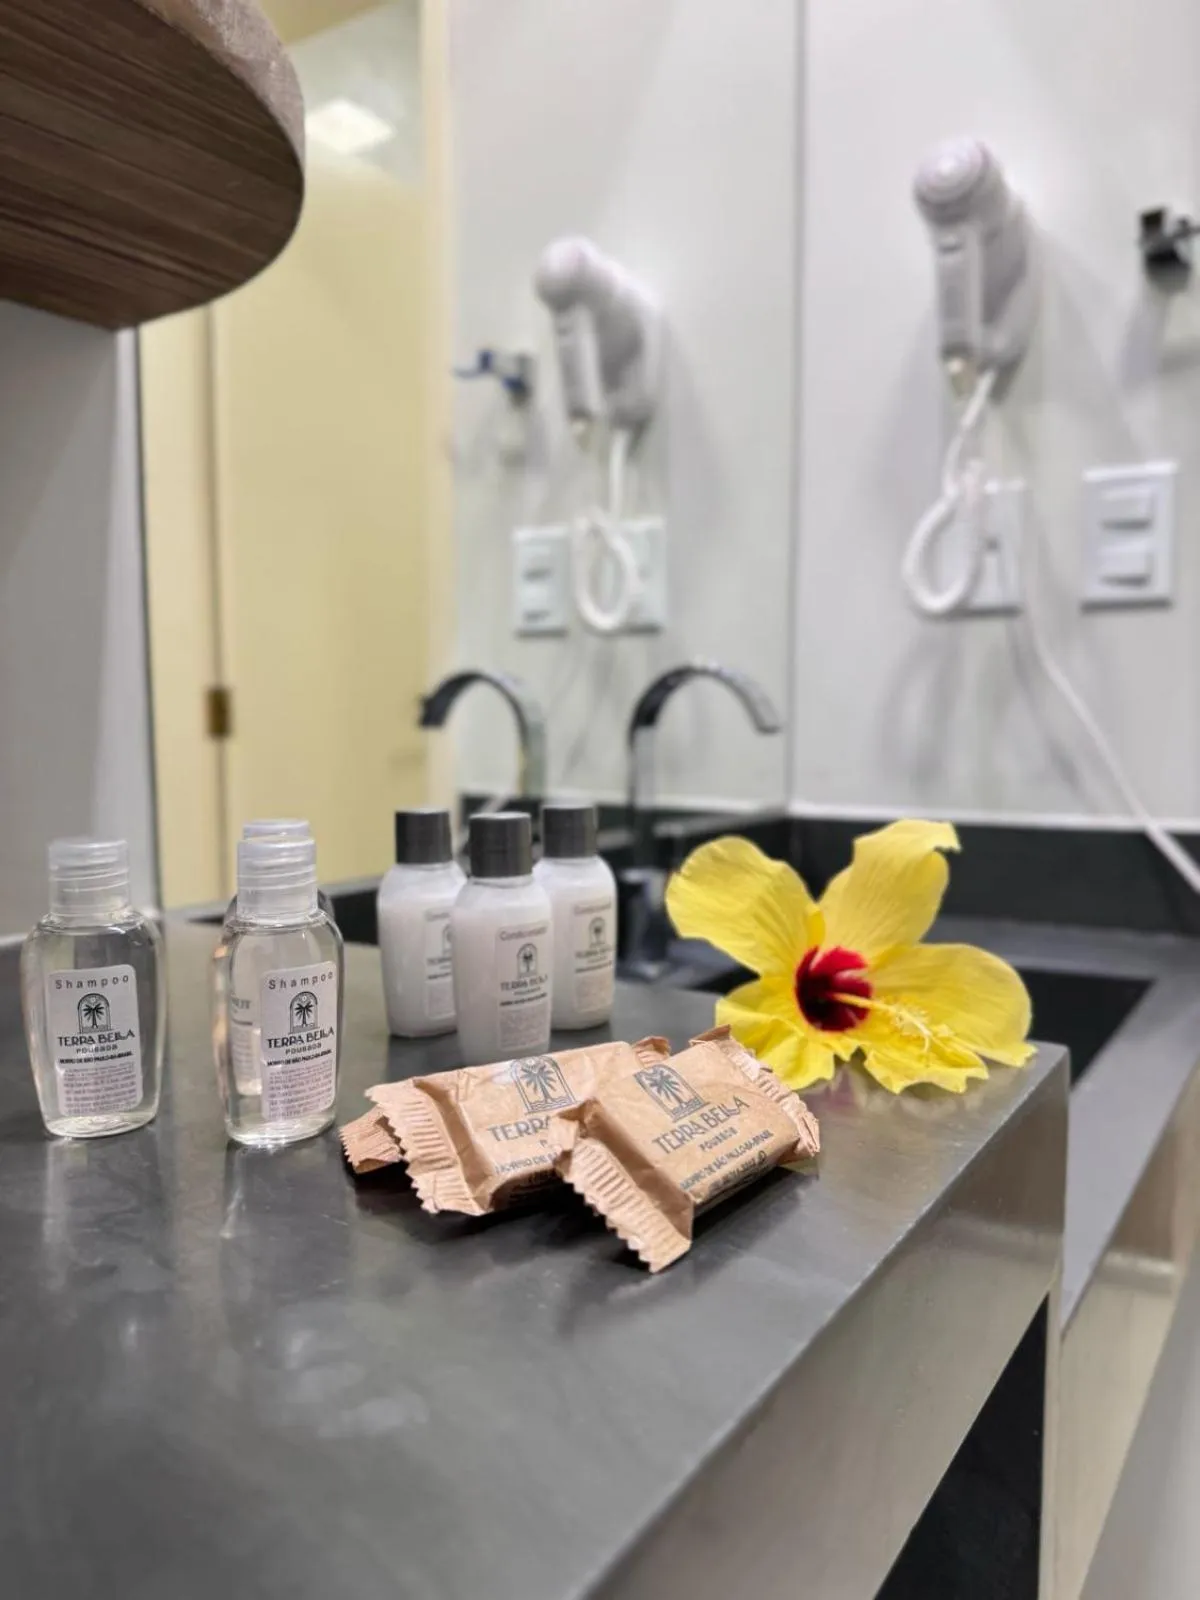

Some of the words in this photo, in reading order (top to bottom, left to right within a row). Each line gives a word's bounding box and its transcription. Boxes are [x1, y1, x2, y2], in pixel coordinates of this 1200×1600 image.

[55, 974, 129, 990] Shampoo
[268, 970, 334, 990] Shampoo
[57, 1034, 96, 1047] TERRA
[97, 1028, 136, 1044] BELLA
[266, 1034, 304, 1049] TERRA
[306, 1026, 335, 1043] BELLA
[652, 1120, 709, 1154] TERRA
[700, 1095, 750, 1128] BELLA
